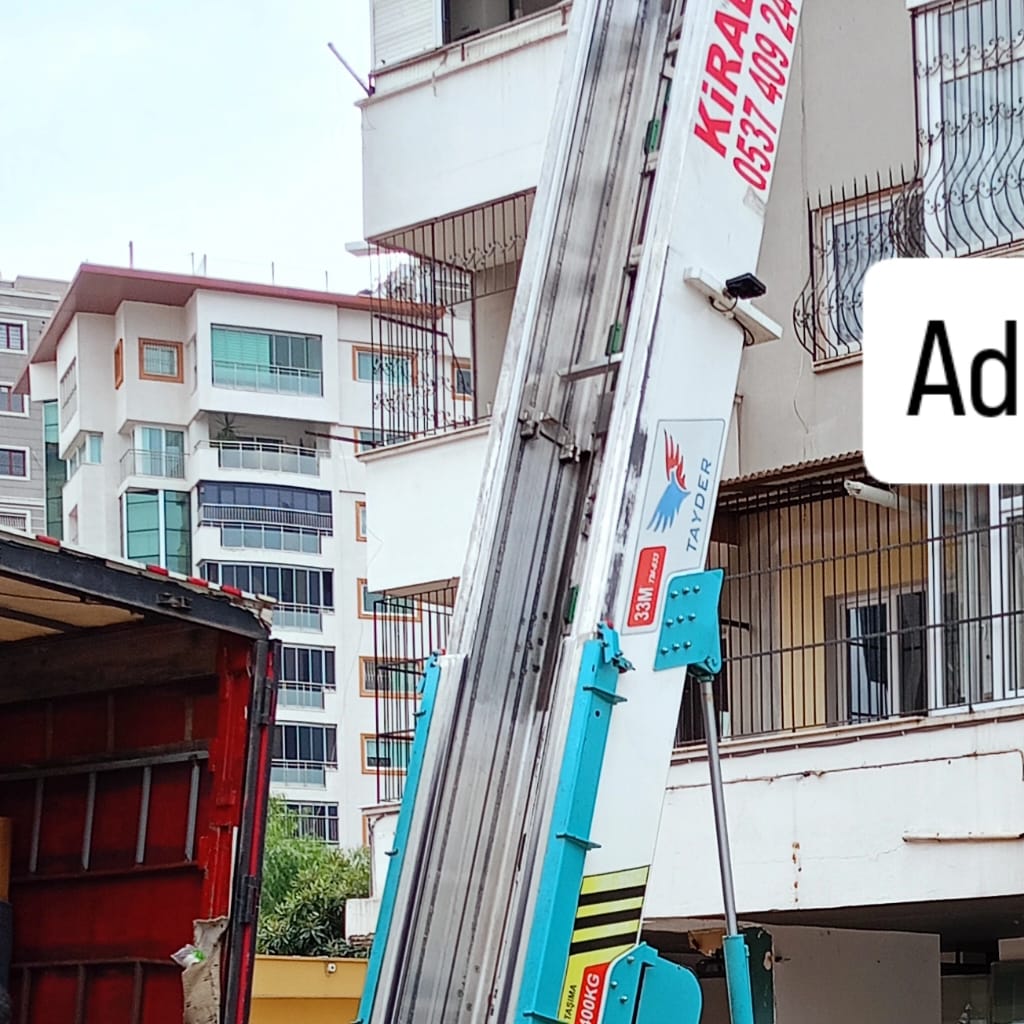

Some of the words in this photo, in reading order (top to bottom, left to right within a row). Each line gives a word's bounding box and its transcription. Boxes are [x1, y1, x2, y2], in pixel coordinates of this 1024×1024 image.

[748, 33, 789, 104] 409
[733, 95, 777, 191] 0537
[686, 457, 712, 552] TAYDER
[634, 587, 654, 621] 33M
[564, 984, 577, 1020] TAŞIMA
